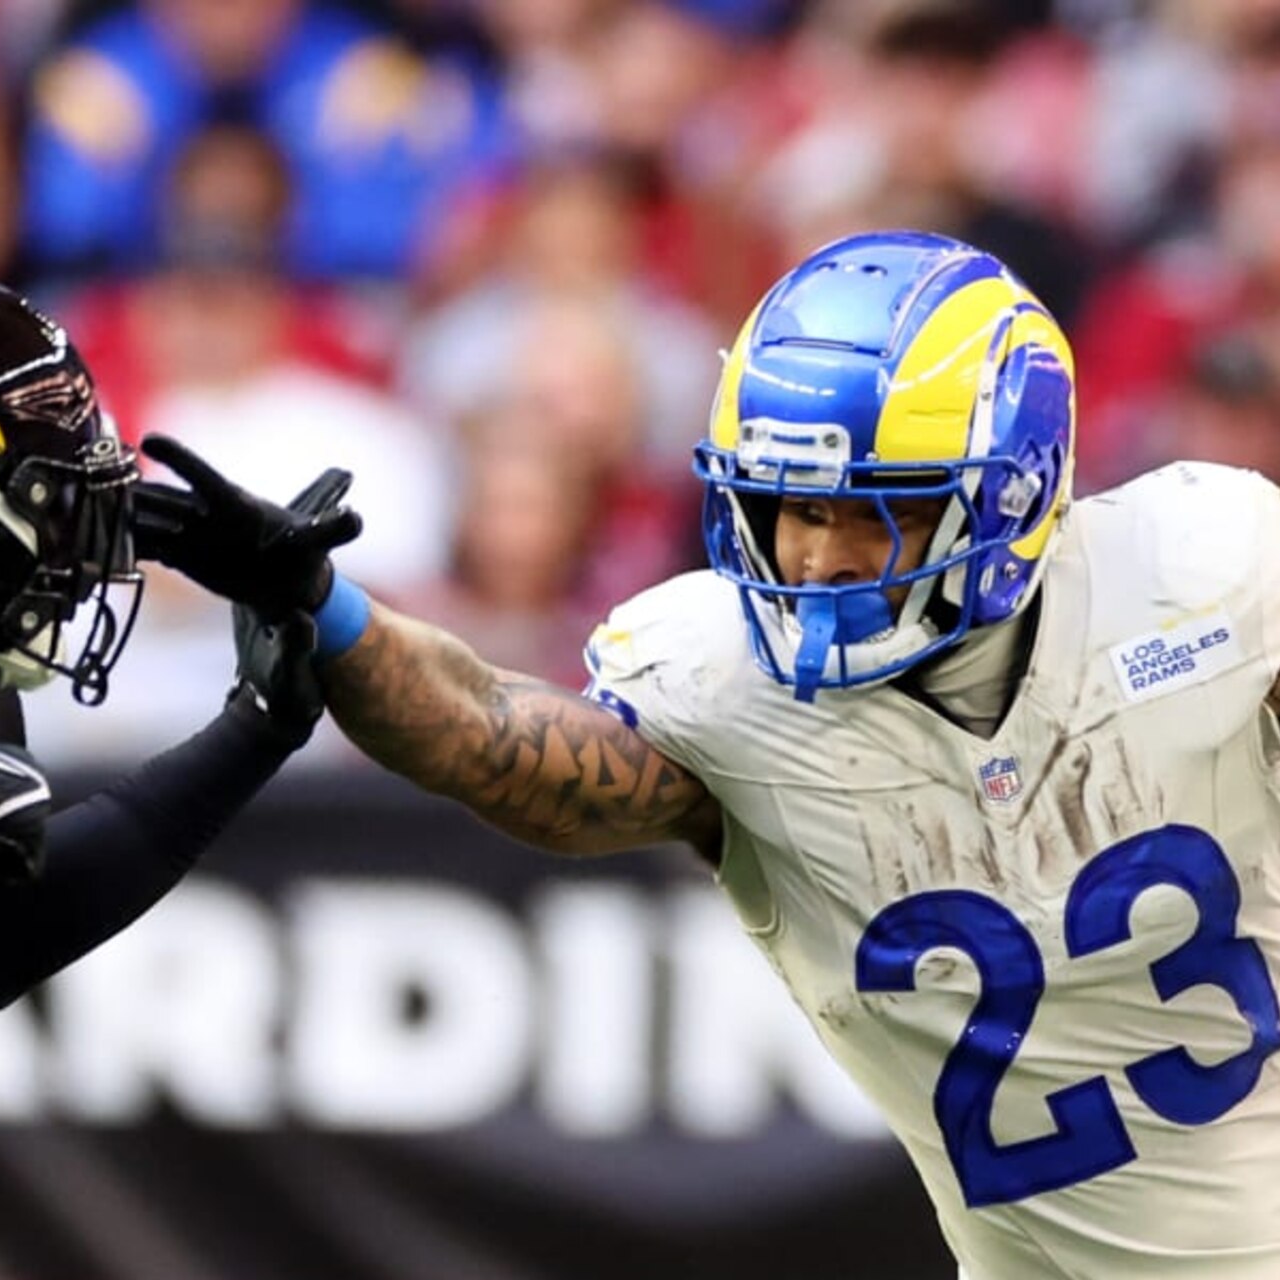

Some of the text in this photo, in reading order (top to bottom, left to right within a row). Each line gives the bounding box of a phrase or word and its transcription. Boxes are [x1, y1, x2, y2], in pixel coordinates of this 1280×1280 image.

[1120, 638, 1167, 666] LOS
[1127, 627, 1230, 679] ANGELES
[1130, 657, 1197, 691] RAMS
